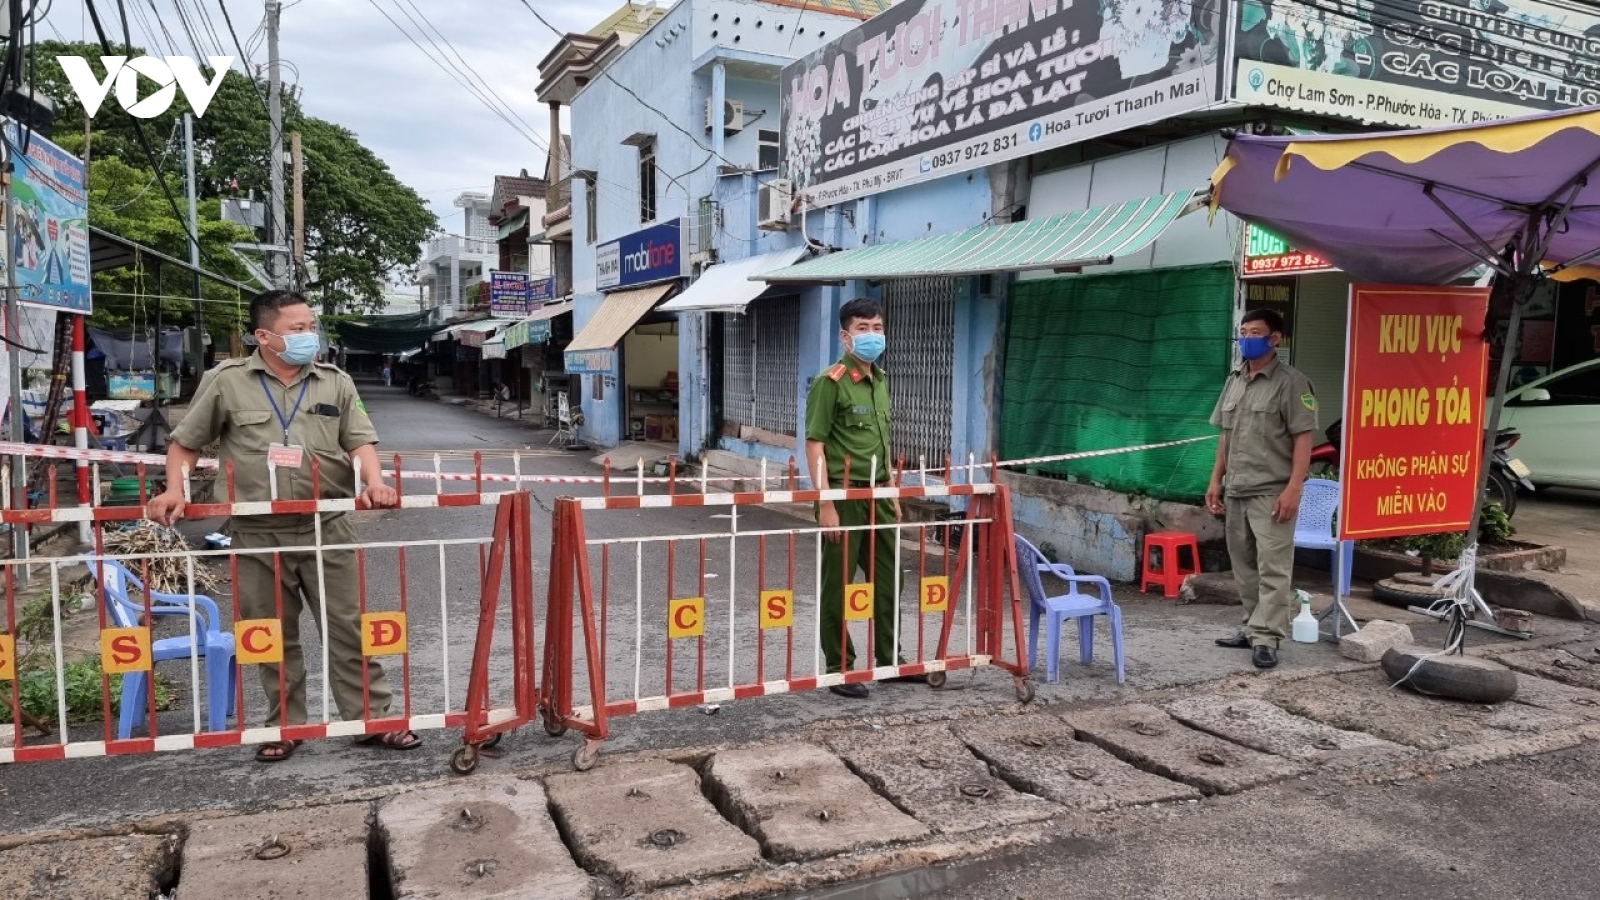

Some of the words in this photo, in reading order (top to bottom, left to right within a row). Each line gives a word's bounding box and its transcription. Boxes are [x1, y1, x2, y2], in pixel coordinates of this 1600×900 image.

[1004, 41, 1038, 69] VÀ
[1381, 51, 1460, 84] CÁC
[1467, 66, 1547, 100] LOẠI
[791, 53, 850, 120] HOA
[1045, 118, 1071, 136] Hoa
[1075, 105, 1110, 126] Tươi
[1115, 90, 1164, 115] Thanh
[1169, 78, 1200, 100] Mai
[1267, 78, 1295, 101] Chợ
[1298, 83, 1325, 102] Lam
[1329, 88, 1355, 106] Sơn
[1366, 93, 1416, 117] P.Phước
[824, 133, 856, 155] CÁC
[906, 102, 937, 126] VỤ
[972, 69, 1032, 105] HOA
[824, 151, 856, 173] CÁC
[859, 135, 900, 162] LOẠI
[902, 119, 952, 148] HOA
[955, 104, 985, 131] LÁ
[988, 91, 1028, 121] ĐÀ
[1032, 70, 1088, 106] LẠT
[932, 149, 961, 169] 0937
[965, 141, 989, 160] 972
[993, 132, 1018, 152] 831
[624, 240, 675, 275] mobifone
[1252, 257, 1279, 270] 0937
[1281, 255, 1301, 266] 972
[1304, 254, 1325, 265] 83
[1379, 314, 1420, 354] KHU
[1426, 314, 1463, 363] VỰC
[1360, 386, 1430, 428] PHONG
[1436, 375, 1471, 425] TỎA
[1356, 453, 1408, 480] KHÔNG
[1411, 450, 1448, 480] PHẬN
[1451, 450, 1471, 478] SỰ
[1377, 485, 1413, 516] MIỄN
[1417, 487, 1447, 513] VÀO
[673, 605, 698, 630] C
[766, 596, 787, 620] S
[849, 589, 870, 612] C
[926, 583, 946, 606] Đ
[110, 635, 142, 666] S
[240, 626, 274, 655] C
[370, 619, 402, 647] Đ
